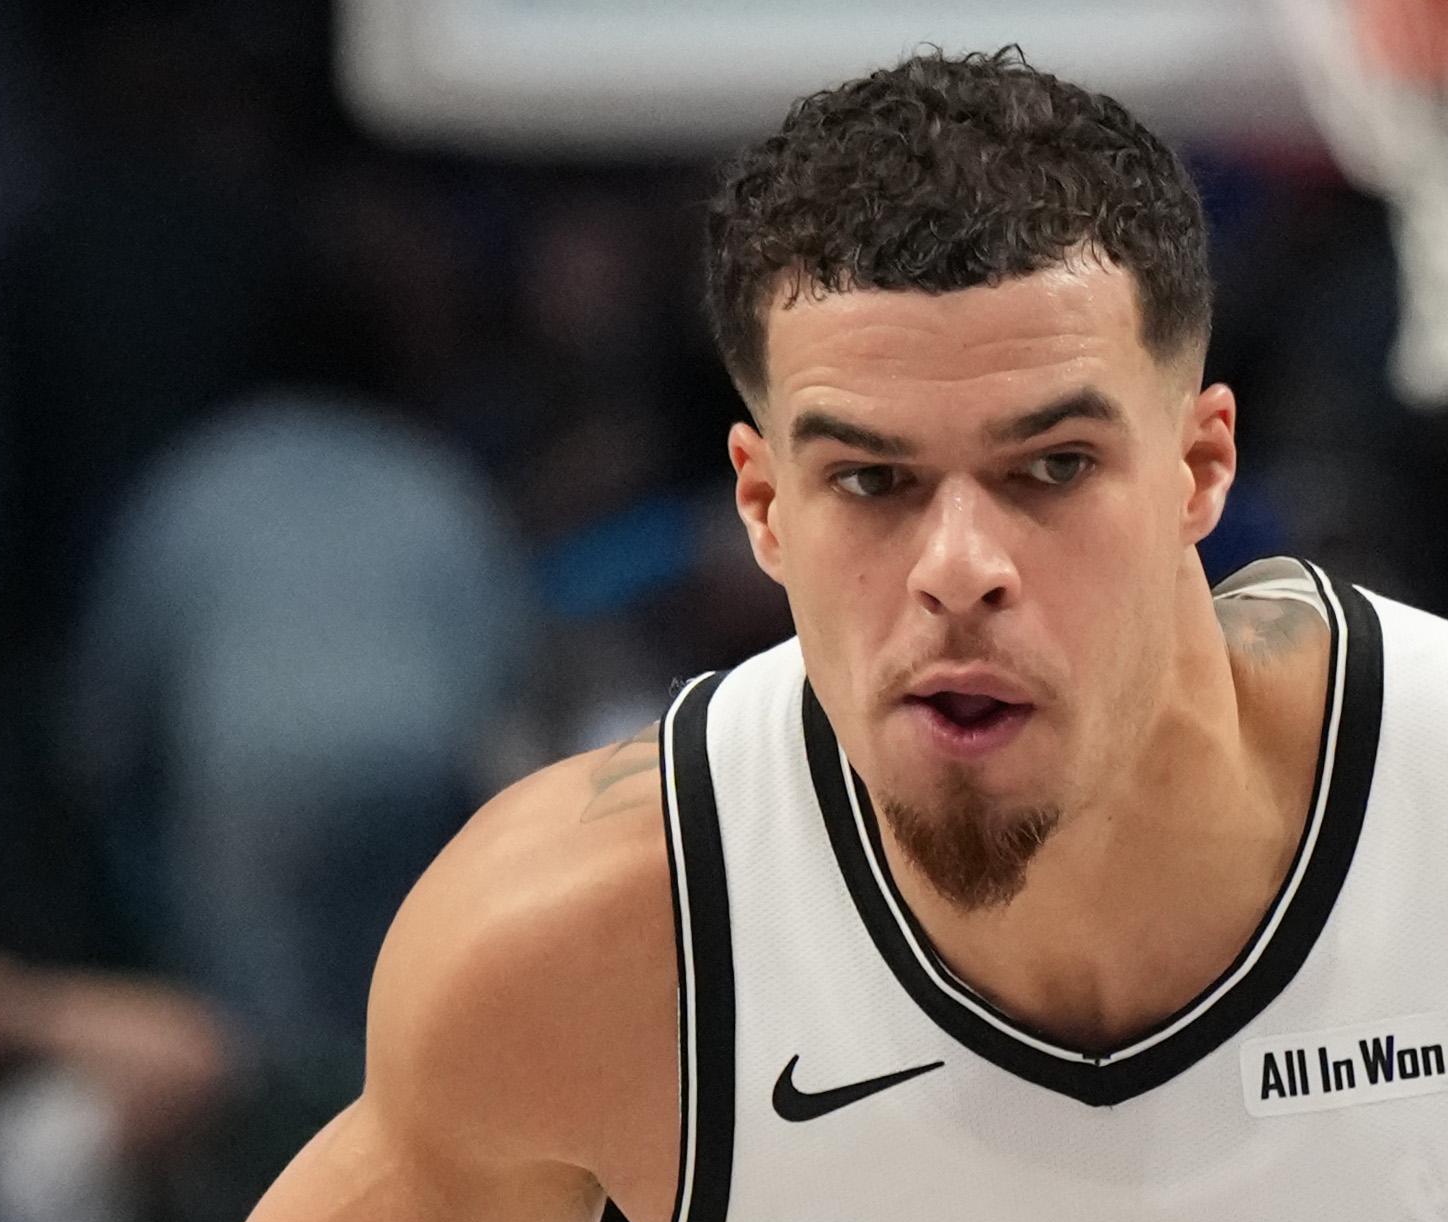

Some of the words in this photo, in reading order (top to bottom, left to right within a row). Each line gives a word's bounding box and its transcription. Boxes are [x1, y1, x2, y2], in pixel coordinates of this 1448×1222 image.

[1261, 1049, 1310, 1100] All
[1318, 1046, 1356, 1093] In
[1358, 1034, 1445, 1085] Won
